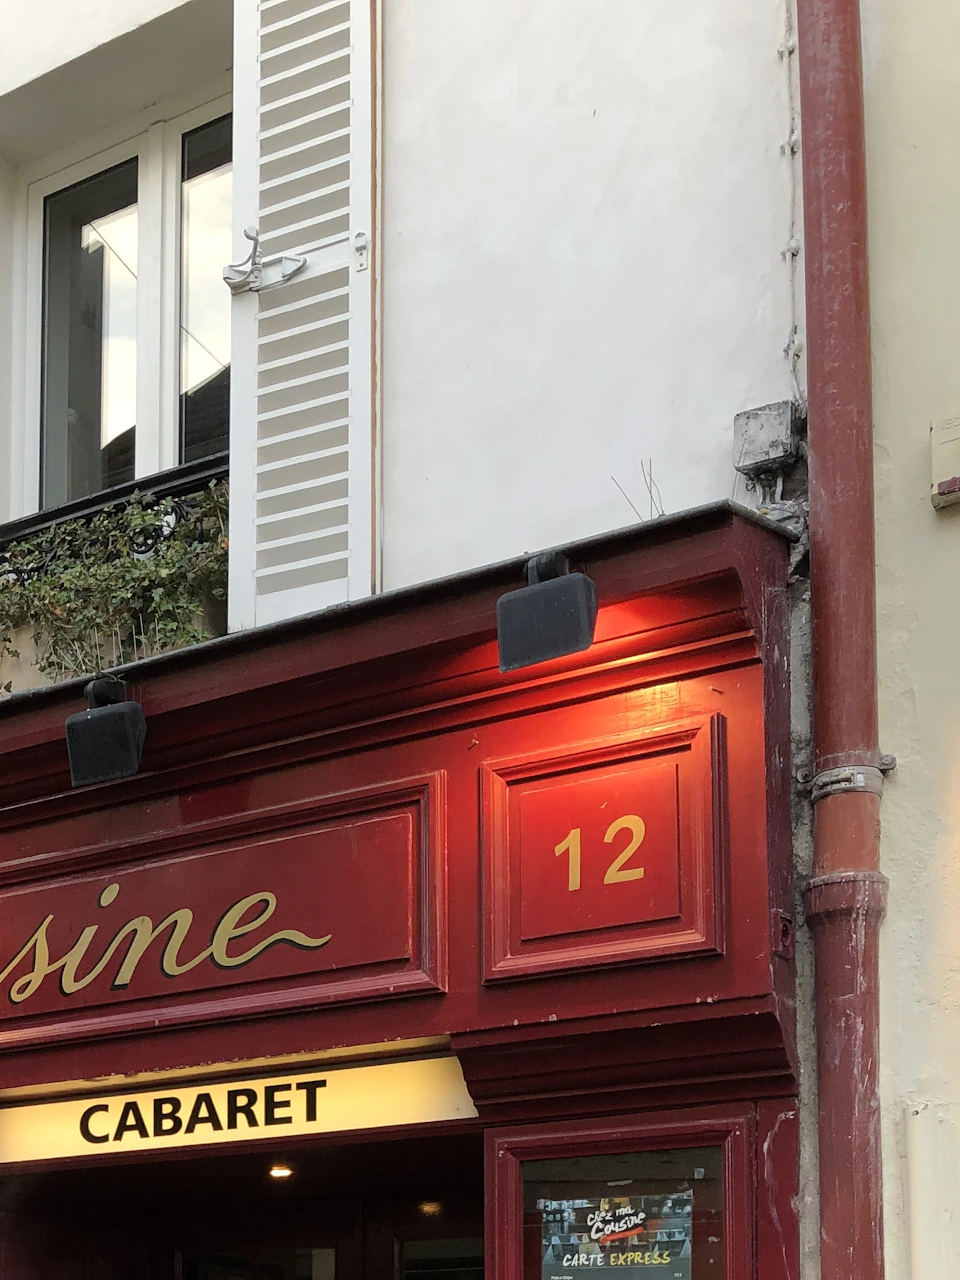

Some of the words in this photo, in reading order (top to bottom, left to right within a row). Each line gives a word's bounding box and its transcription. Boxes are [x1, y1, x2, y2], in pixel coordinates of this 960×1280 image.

[554, 815, 645, 893] 12
[79, 1079, 327, 1145] CABARET
[587, 1211, 613, 1226] Chez
[616, 1205, 635, 1215] ma
[590, 1212, 646, 1239] Cousine
[563, 1254, 604, 1266] CARTE
[610, 1251, 671, 1266] EXPRESS
